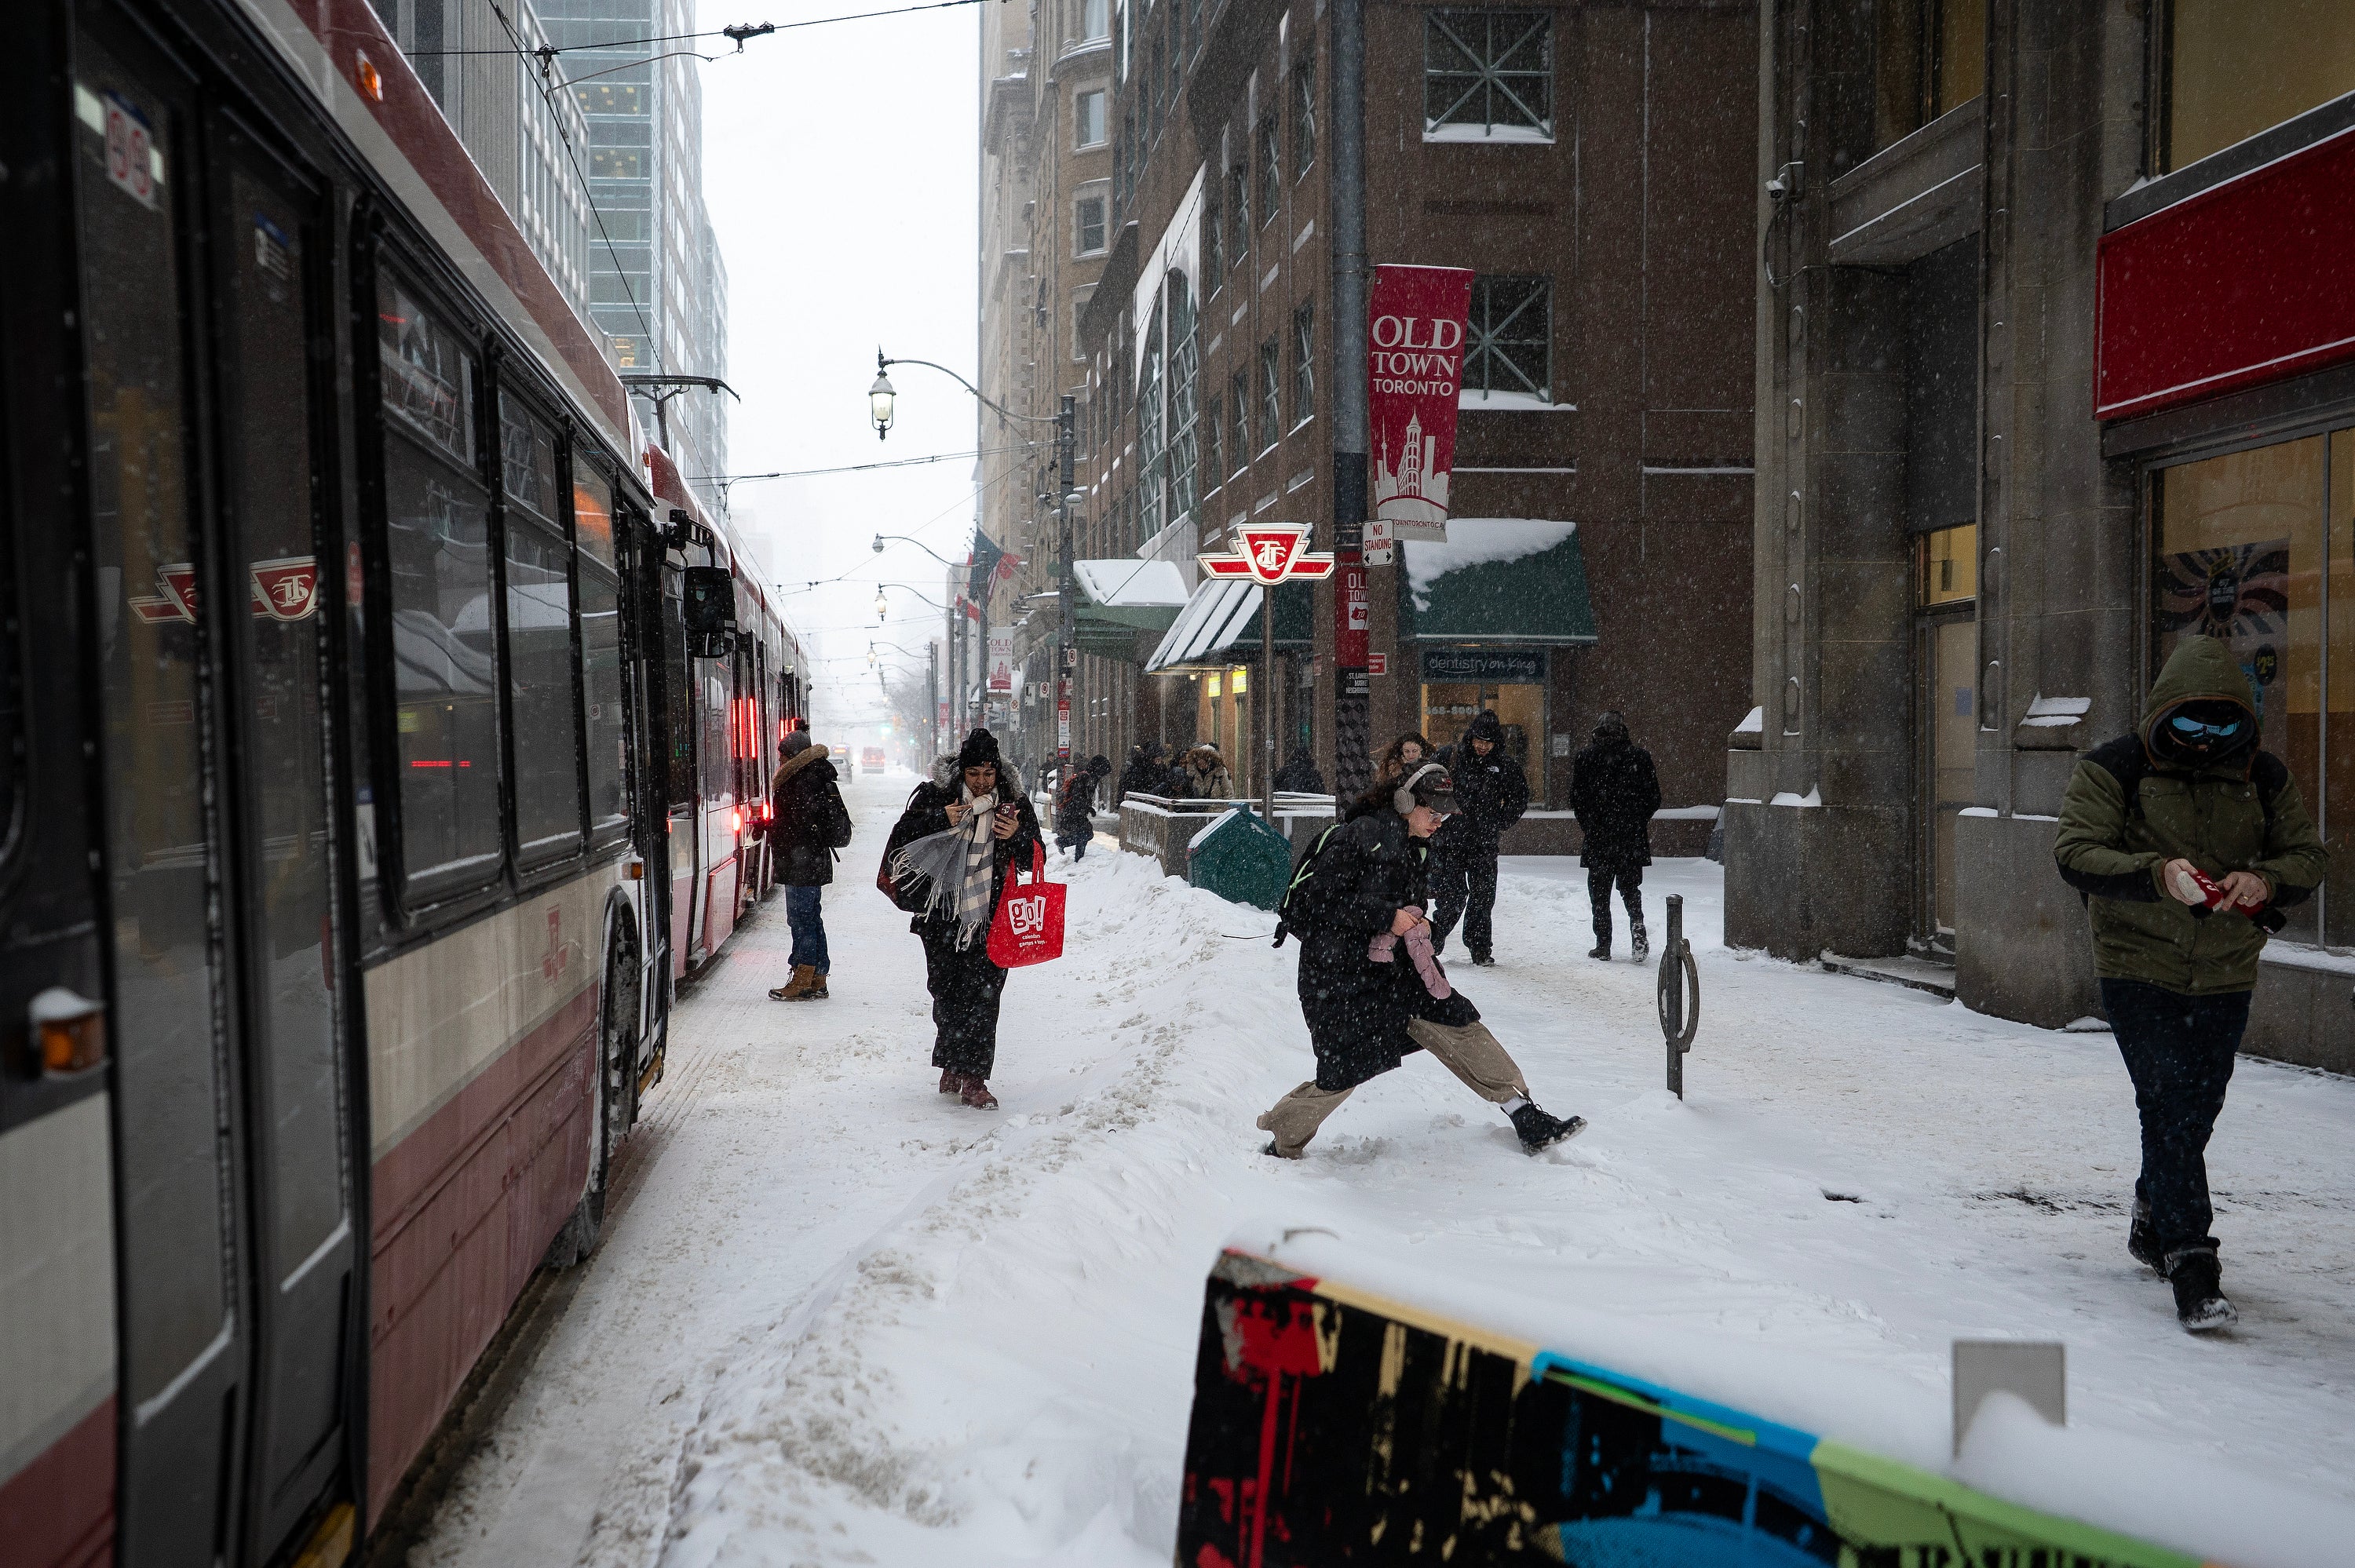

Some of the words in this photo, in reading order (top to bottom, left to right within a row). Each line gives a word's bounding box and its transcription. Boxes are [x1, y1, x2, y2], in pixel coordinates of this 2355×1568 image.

[1372, 315, 1461, 349] OLD
[1371, 352, 1459, 377] TOWN
[1373, 378, 1453, 396] TORONTO
[1373, 524, 1383, 536] NO
[1392, 519, 1444, 529] TOWNTORONTO.CA
[1364, 538, 1392, 551] STANDING
[1348, 573, 1369, 589] OL
[1429, 656, 1488, 671] dentistry
[1011, 899, 1042, 929] go!
